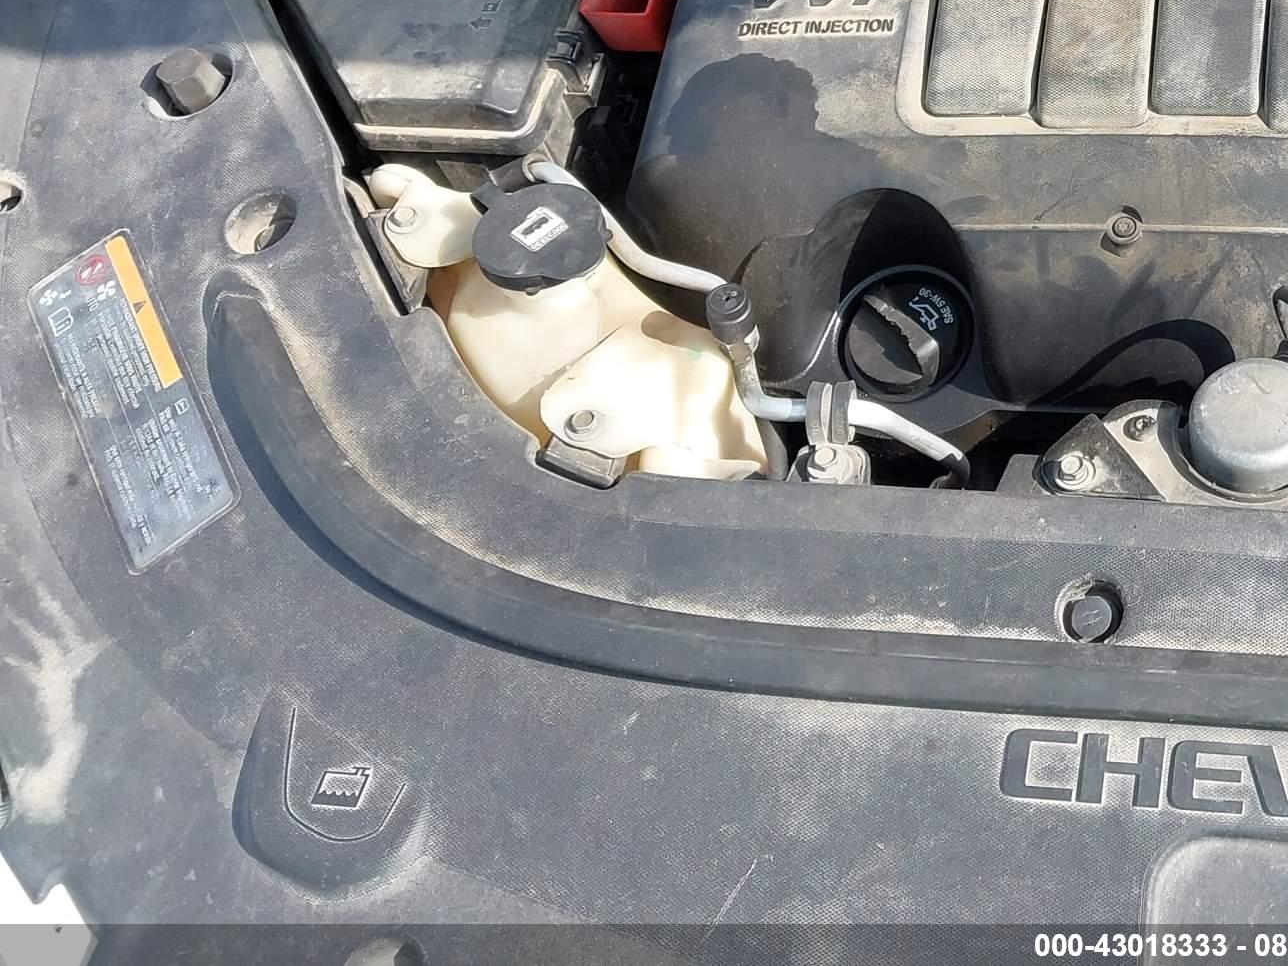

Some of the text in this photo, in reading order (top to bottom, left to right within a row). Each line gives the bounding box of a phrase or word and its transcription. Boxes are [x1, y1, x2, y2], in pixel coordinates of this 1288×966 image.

[737, 18, 896, 38] DIRECT INJECTION
[918, 287, 954, 324] SAE 5W-30
